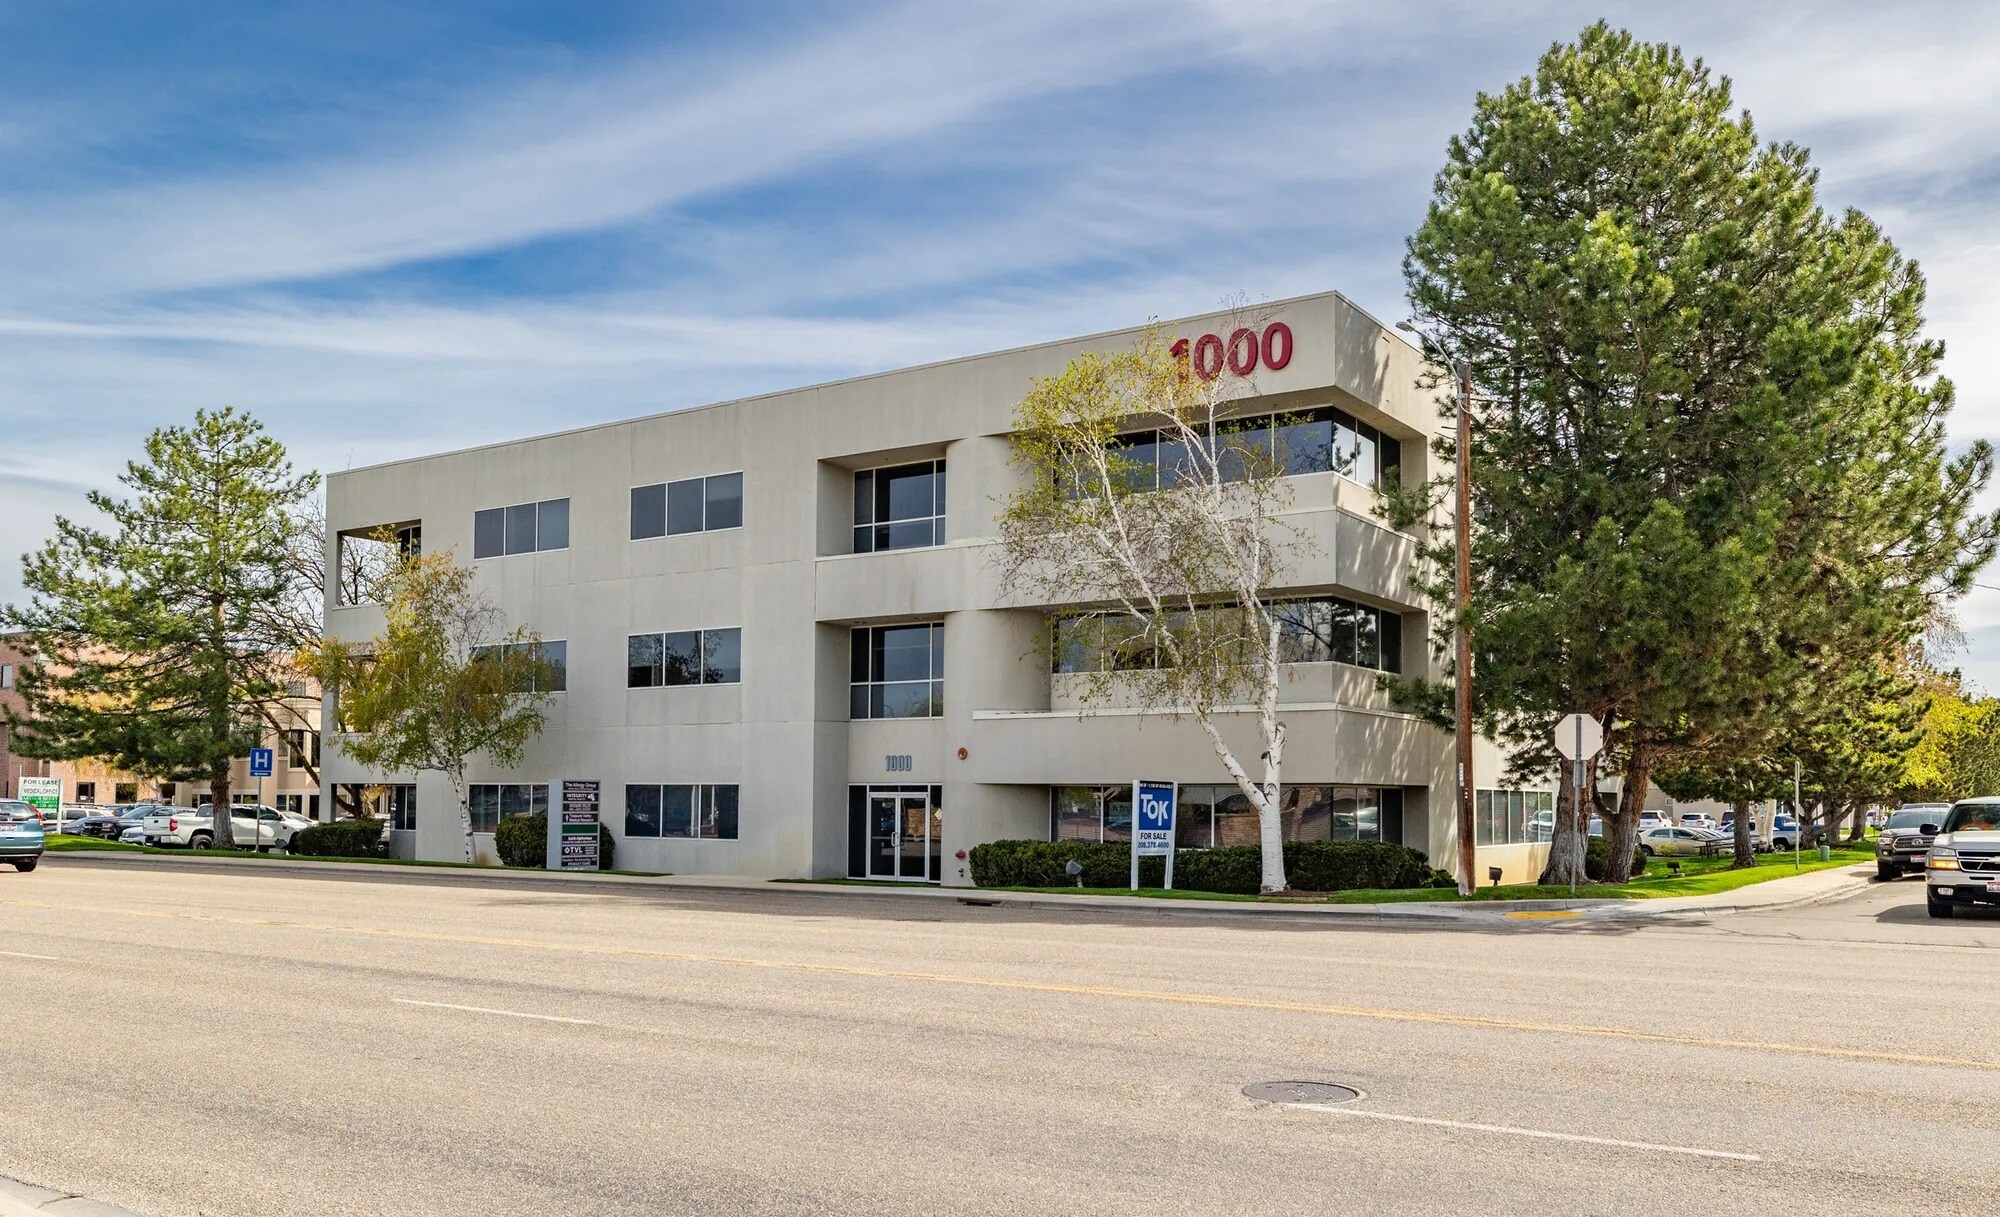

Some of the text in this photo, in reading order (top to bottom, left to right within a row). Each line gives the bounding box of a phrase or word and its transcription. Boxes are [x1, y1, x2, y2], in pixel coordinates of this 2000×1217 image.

[255, 752, 268, 768] H
[885, 755, 912, 772] 1000
[1140, 794, 1169, 826] TOK
[1140, 832, 1167, 840] FOR SALE
